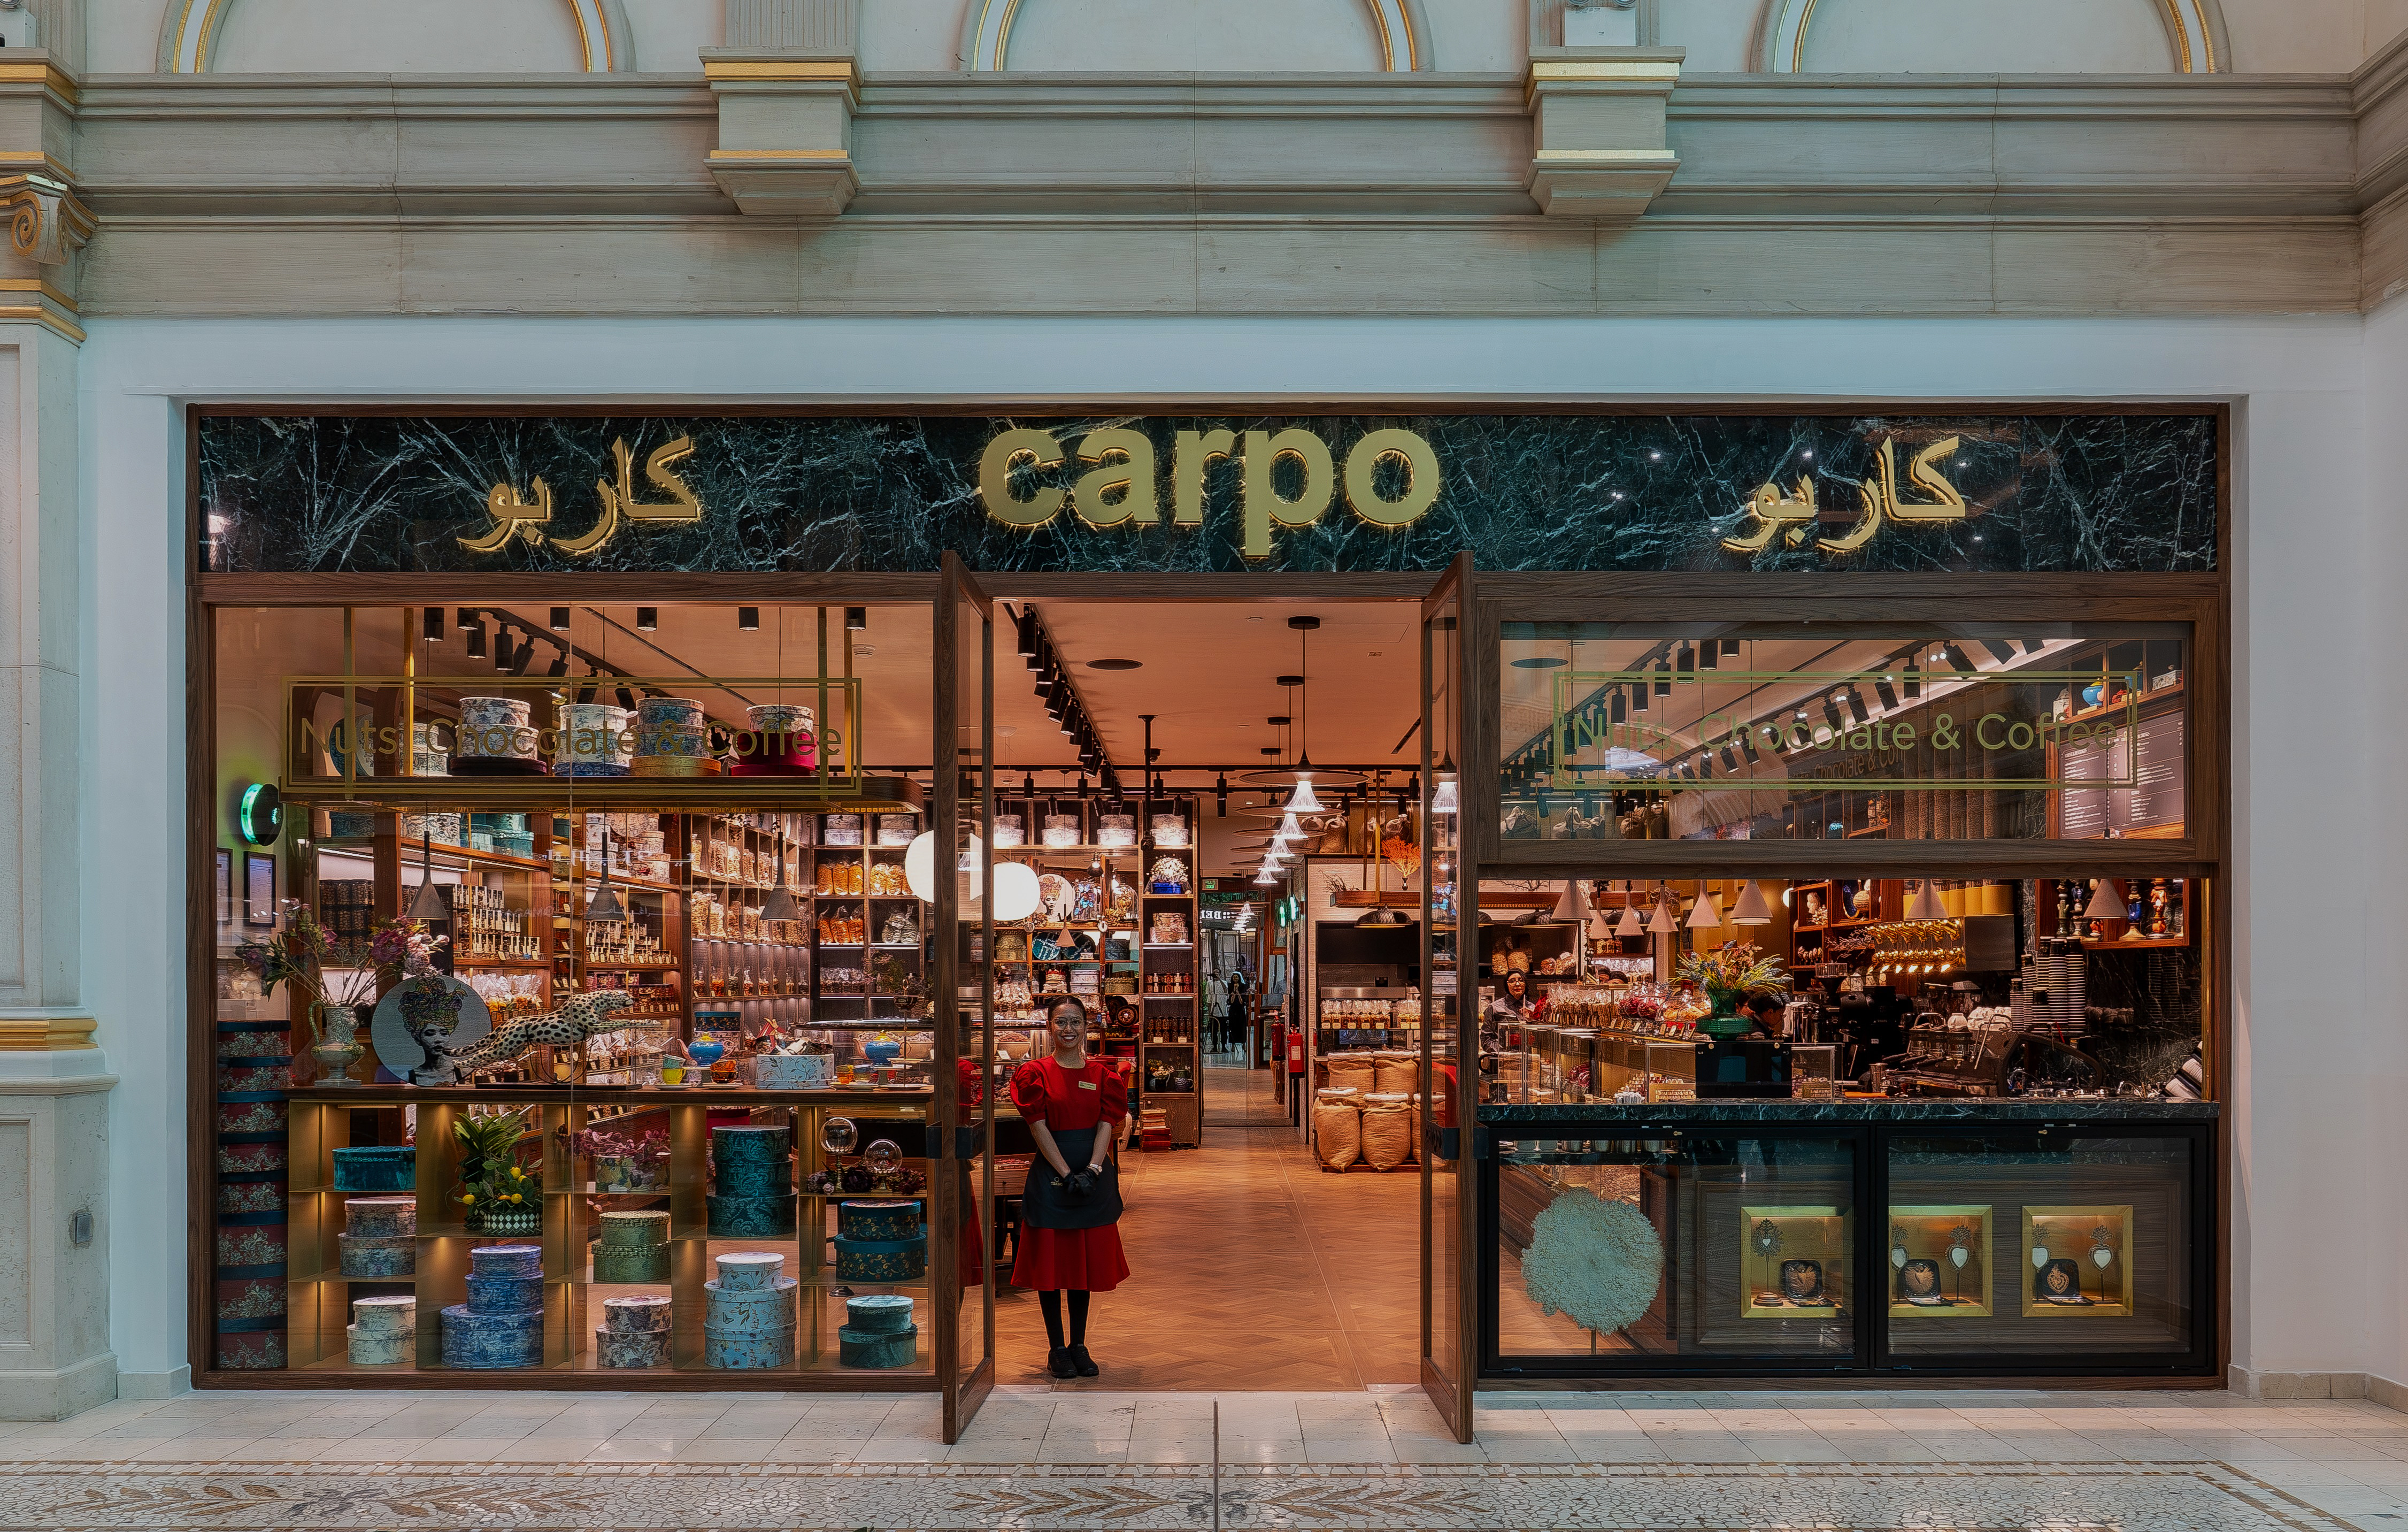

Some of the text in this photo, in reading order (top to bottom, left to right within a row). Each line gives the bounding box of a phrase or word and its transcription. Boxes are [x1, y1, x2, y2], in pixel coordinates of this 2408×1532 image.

[979, 428, 1439, 556] carpo
[427, 717, 641, 756] Chocolate
[656, 718, 683, 755] &
[702, 718, 842, 756] Coffee
[1698, 713, 1917, 750] Chocolate
[1930, 713, 1961, 750] &
[1978, 711, 2118, 750] Coffee
